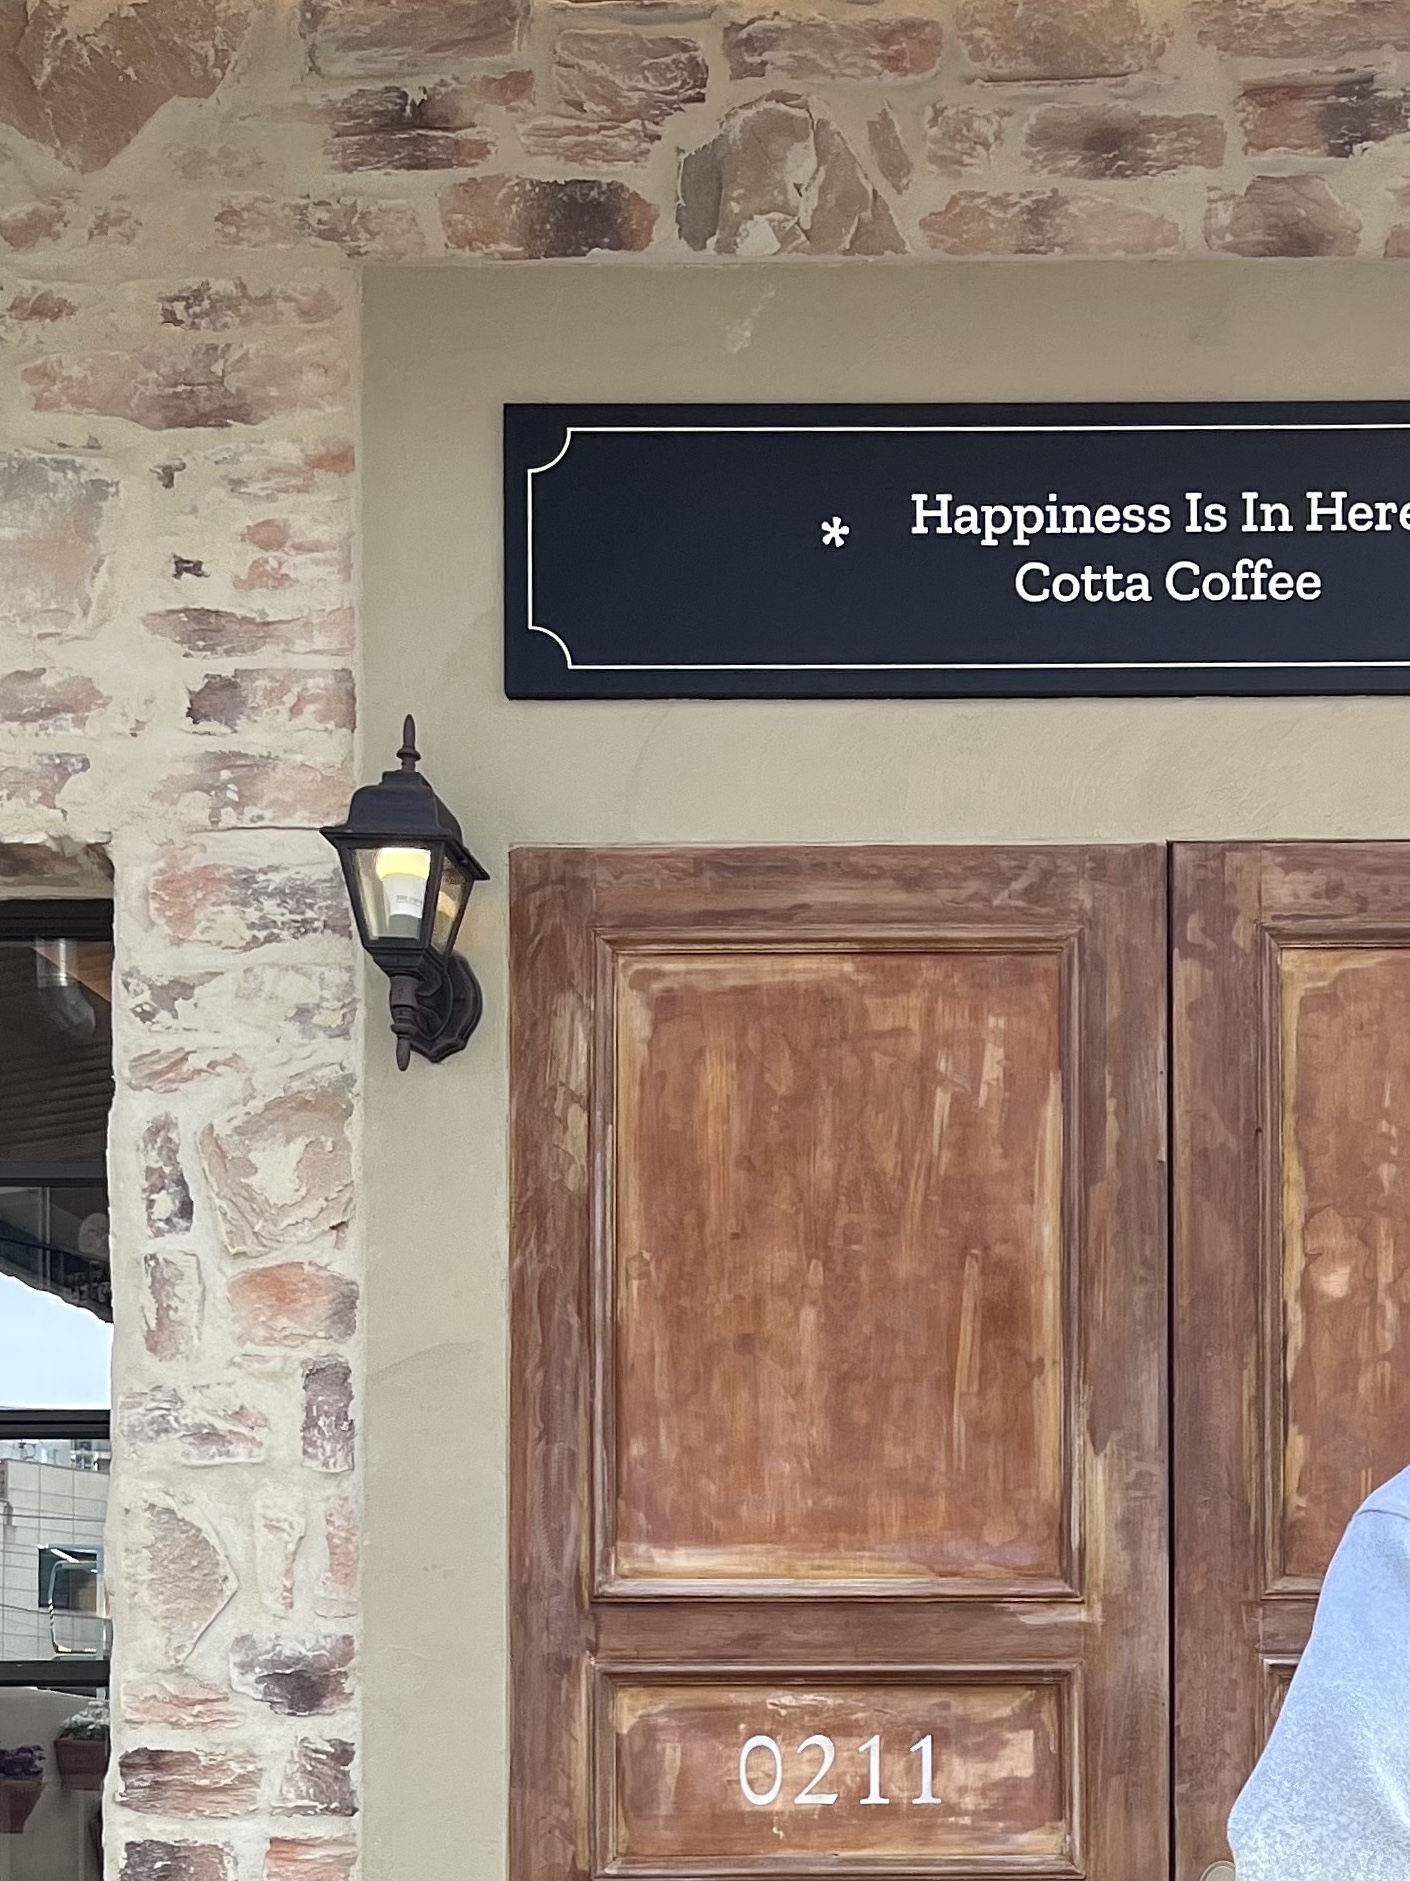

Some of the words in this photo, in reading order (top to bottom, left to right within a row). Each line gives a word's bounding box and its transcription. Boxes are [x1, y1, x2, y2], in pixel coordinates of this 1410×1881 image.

[911, 493, 1171, 546] Happiness
[1185, 492, 1227, 533] Is
[1241, 491, 1294, 532] In
[1015, 561, 1153, 603] Cotta
[1165, 558, 1322, 602] Coffee
[739, 1734, 942, 1806] 0211
